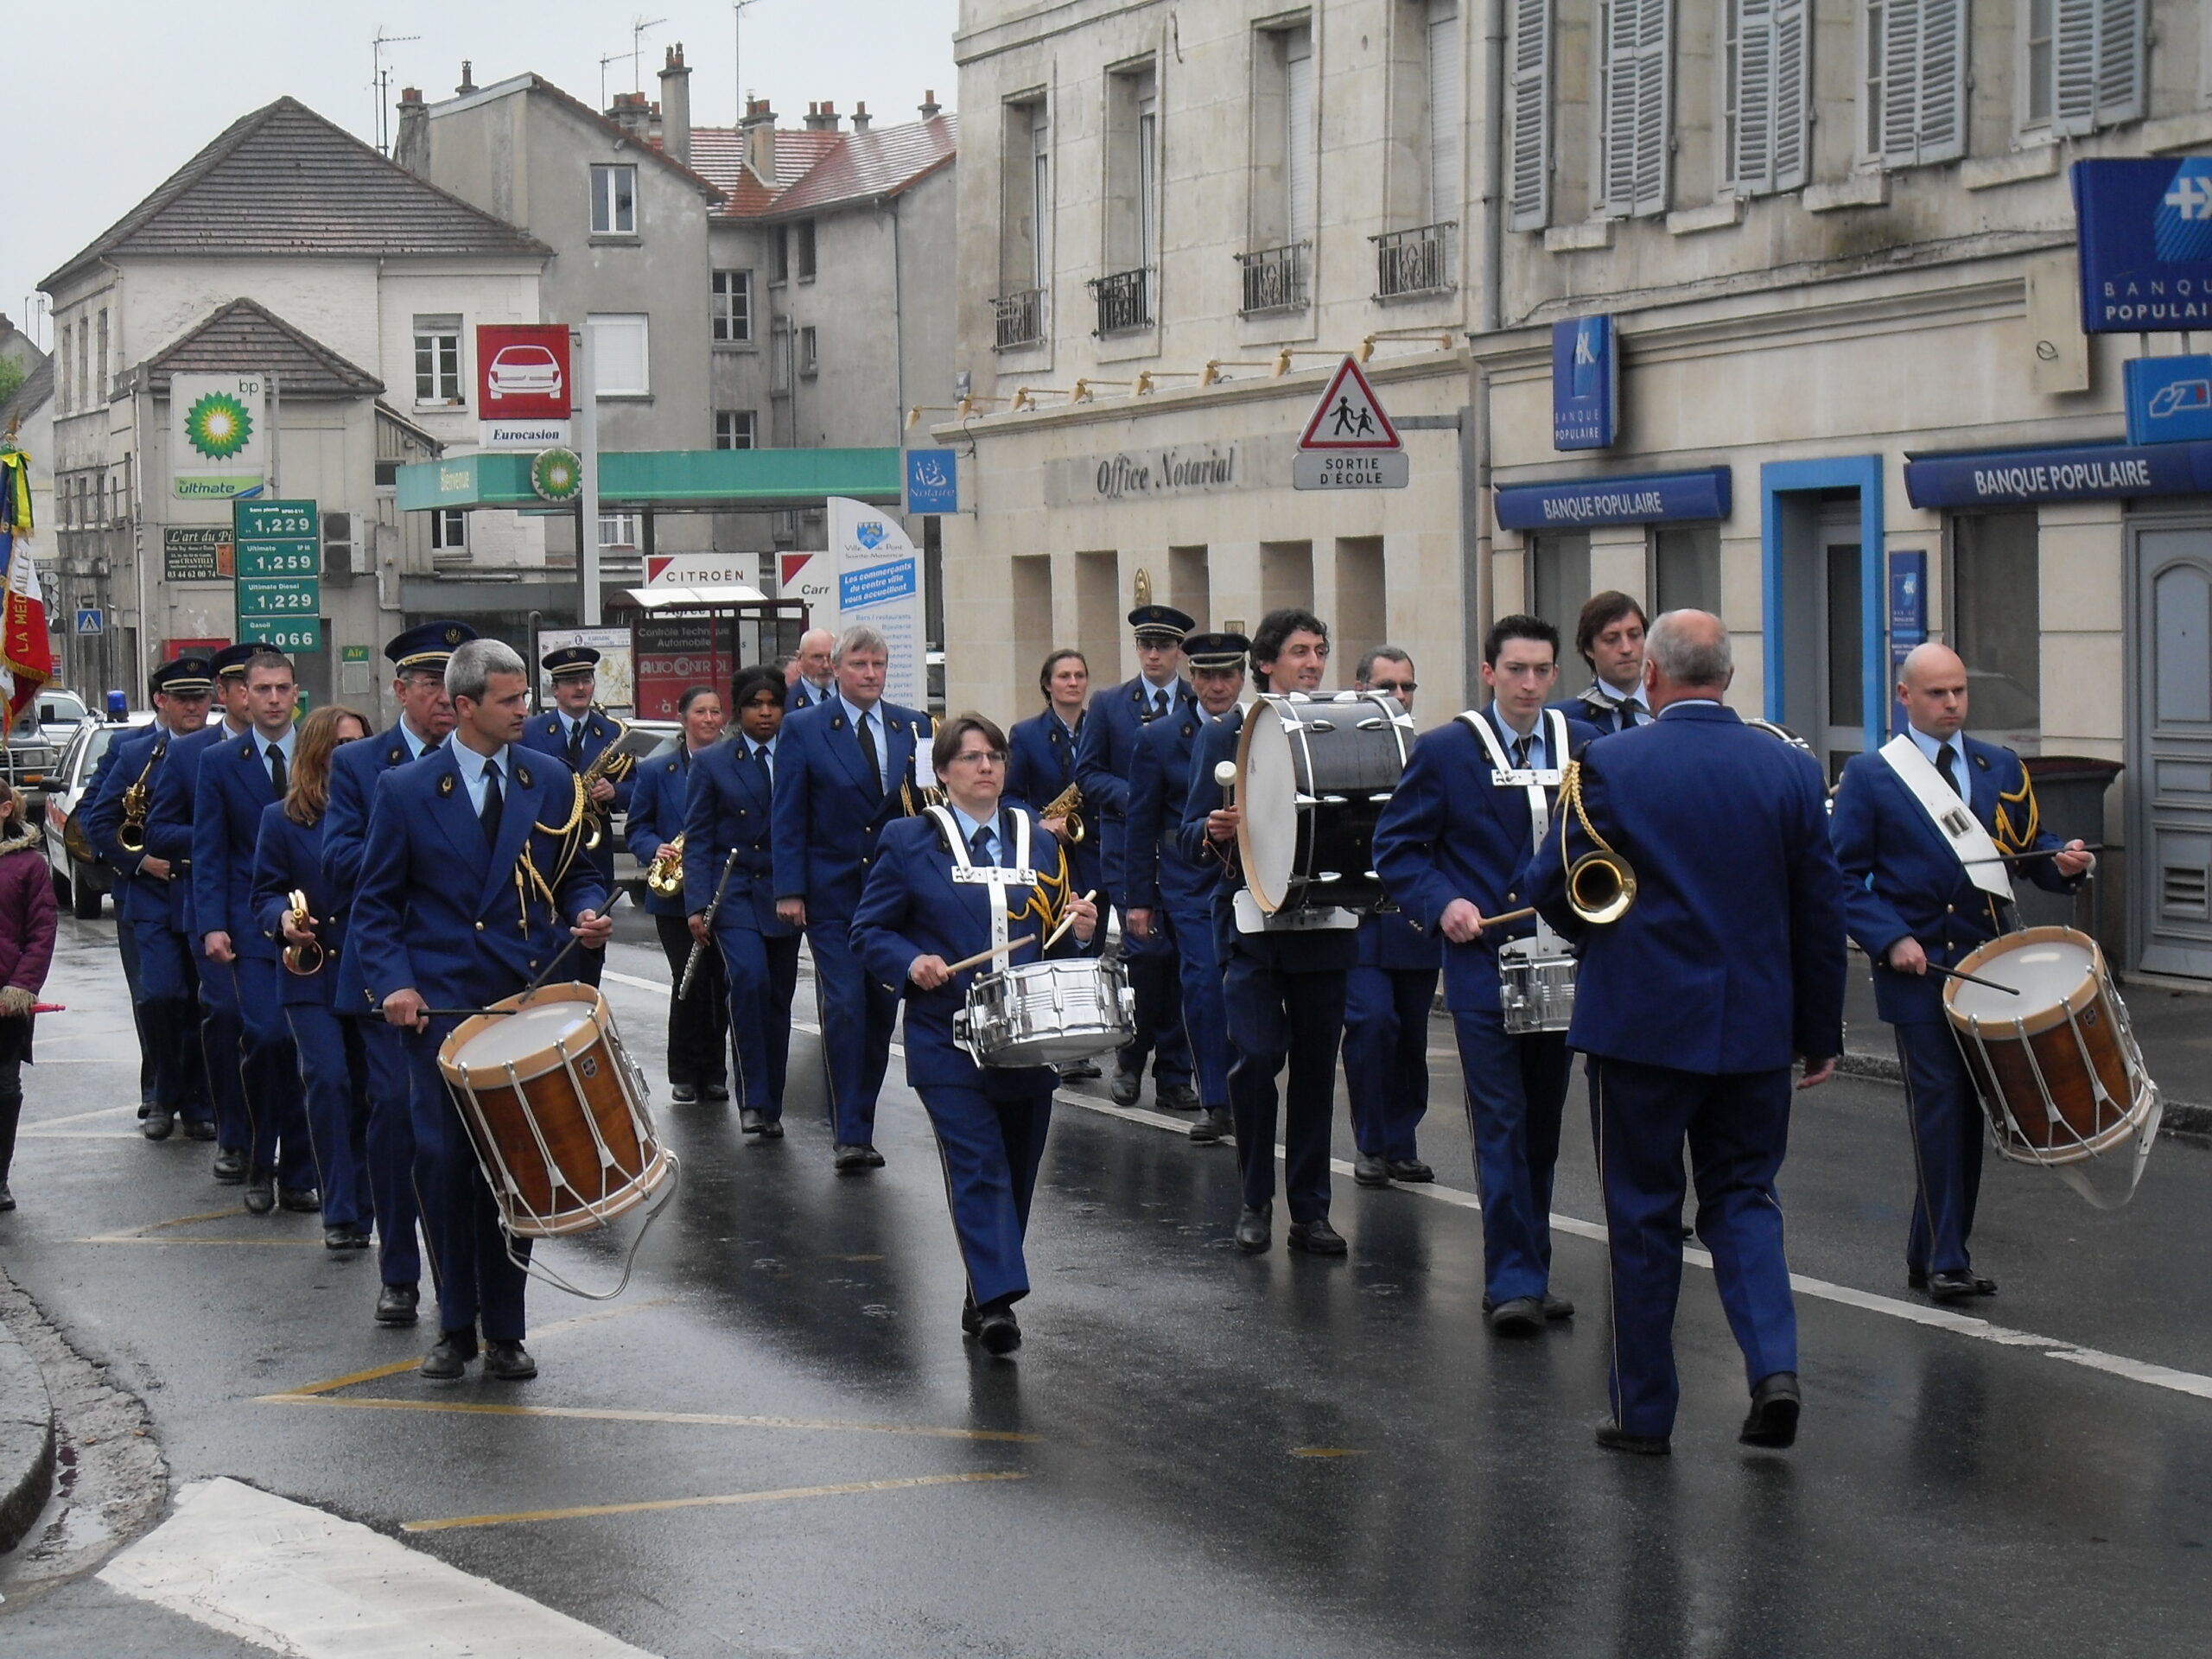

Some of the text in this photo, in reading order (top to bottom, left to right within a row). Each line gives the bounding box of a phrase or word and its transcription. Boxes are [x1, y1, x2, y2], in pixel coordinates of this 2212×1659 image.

[2106, 303, 2208, 321] POPULAI
[239, 379, 258, 396] bp
[1555, 409, 1599, 423] BANQUE
[493, 429, 559, 440] Eurocasion
[1555, 427, 1599, 440] POPULAIRE
[1325, 458, 1378, 469] SORTIE
[1097, 447, 1234, 499] Office Notarial
[1320, 471, 1382, 485] D'ÉCOLE
[1974, 460, 2151, 497] BANQUE POPULAIRE
[179, 482, 235, 493] ultimate
[911, 488, 955, 497] Notaire
[1543, 492, 1663, 521] BANQUE POPULAIRE
[256, 518, 309, 533] 1,229
[170, 530, 198, 542] L'art
[201, 529, 215, 542] du
[257, 556, 311, 571] 1,259
[666, 569, 744, 582] CITROËN
[844, 563, 912, 584] Les commerçants
[849, 575, 904, 593] du centre ville
[863, 583, 907, 599] accueillent
[257, 594, 311, 610] 1,229
[639, 627, 678, 637] Contrôle
[16, 632, 29, 653] LA
[658, 638, 712, 648] Automobile
[347, 648, 363, 658] Air
